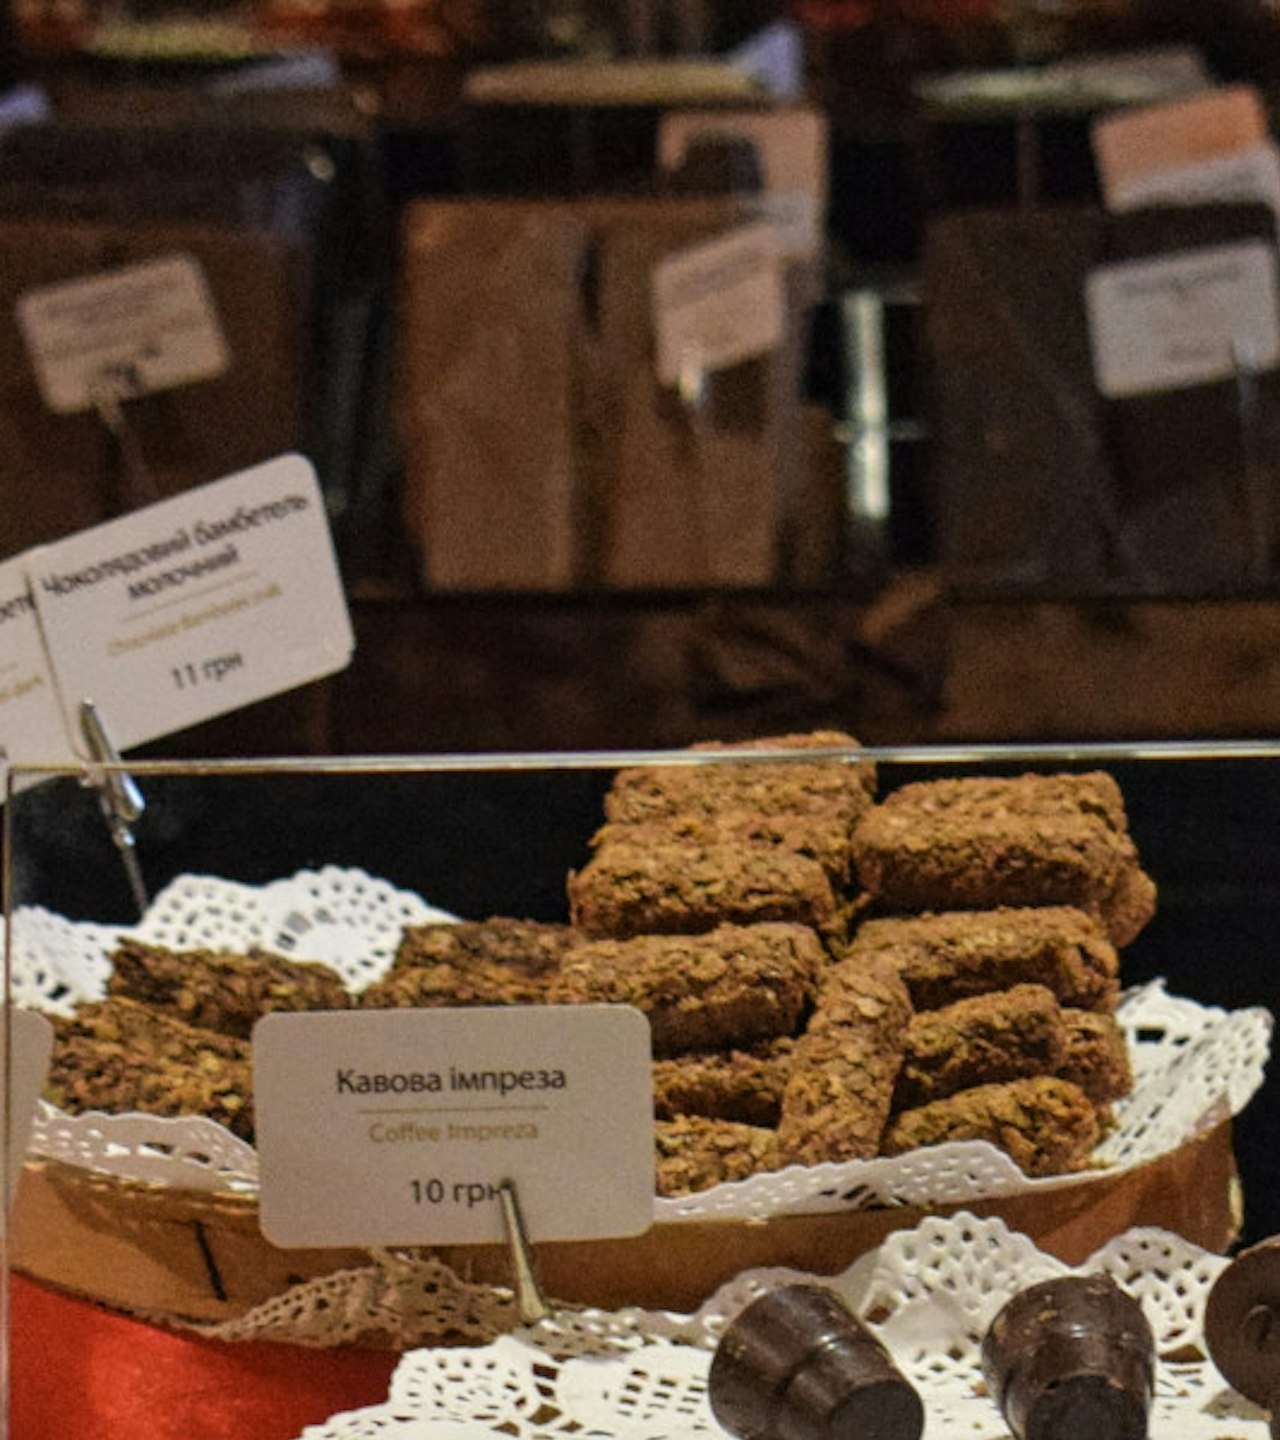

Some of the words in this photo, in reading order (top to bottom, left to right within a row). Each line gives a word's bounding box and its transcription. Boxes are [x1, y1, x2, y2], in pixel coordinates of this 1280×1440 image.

[172, 660, 198, 691] 11
[202, 651, 244, 682] грн
[335, 1068, 442, 1095] Кавова
[450, 1066, 567, 1096] імпреза
[369, 1122, 440, 1145] Coffee
[409, 1178, 445, 1204] 10
